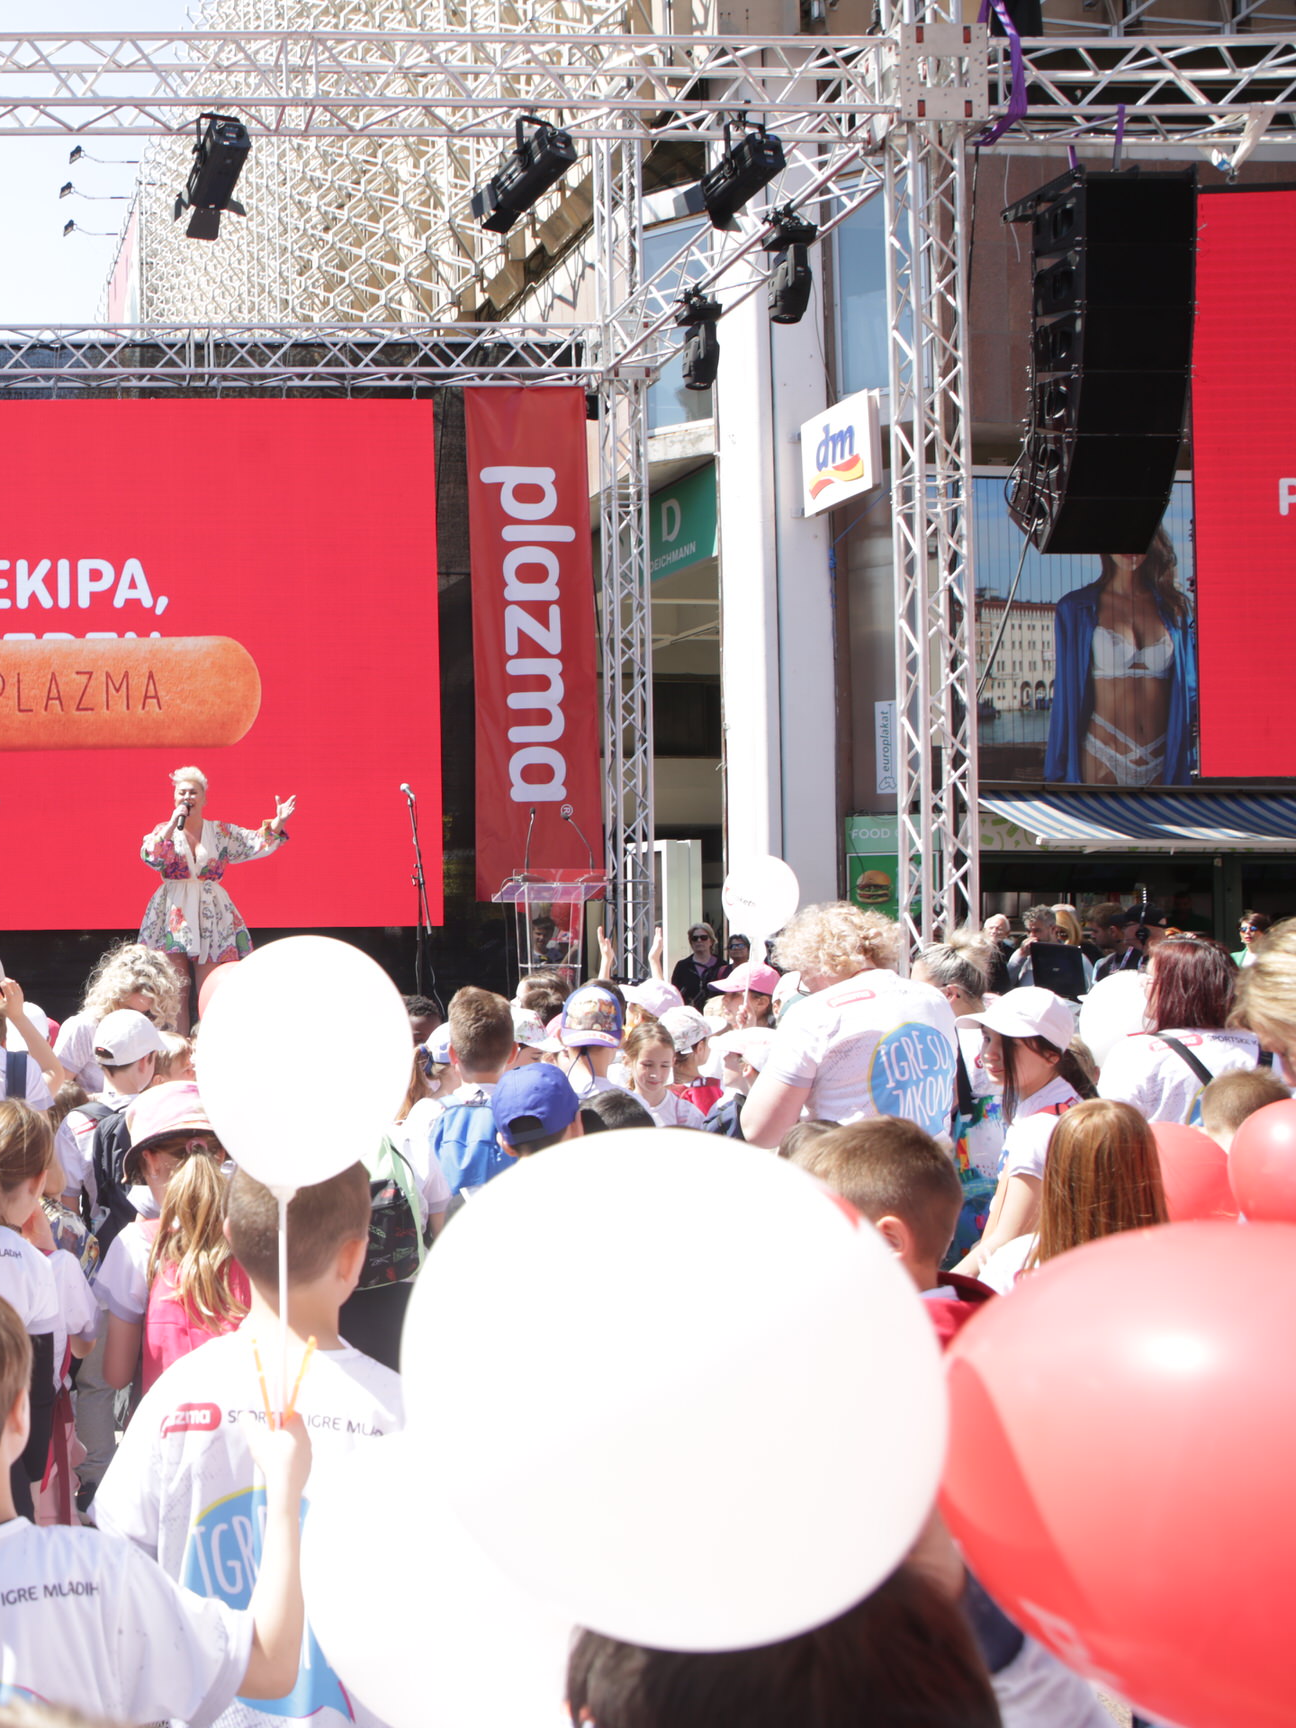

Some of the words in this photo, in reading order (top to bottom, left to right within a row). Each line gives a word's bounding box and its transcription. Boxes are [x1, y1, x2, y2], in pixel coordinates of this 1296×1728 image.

[815, 423, 855, 472] dm
[661, 498, 682, 543] D
[649, 541, 696, 573] DEICHMANN
[479, 465, 576, 803] plazma
[879, 710, 891, 772] europlakat
[851, 828, 890, 839] FOOD
[877, 1030, 929, 1088] IGRE
[926, 1034, 953, 1070] SU
[307, 1413, 342, 1431] IGRE
[0, 1586, 38, 1607] IGRE
[43, 1581, 100, 1599] MLADIH
